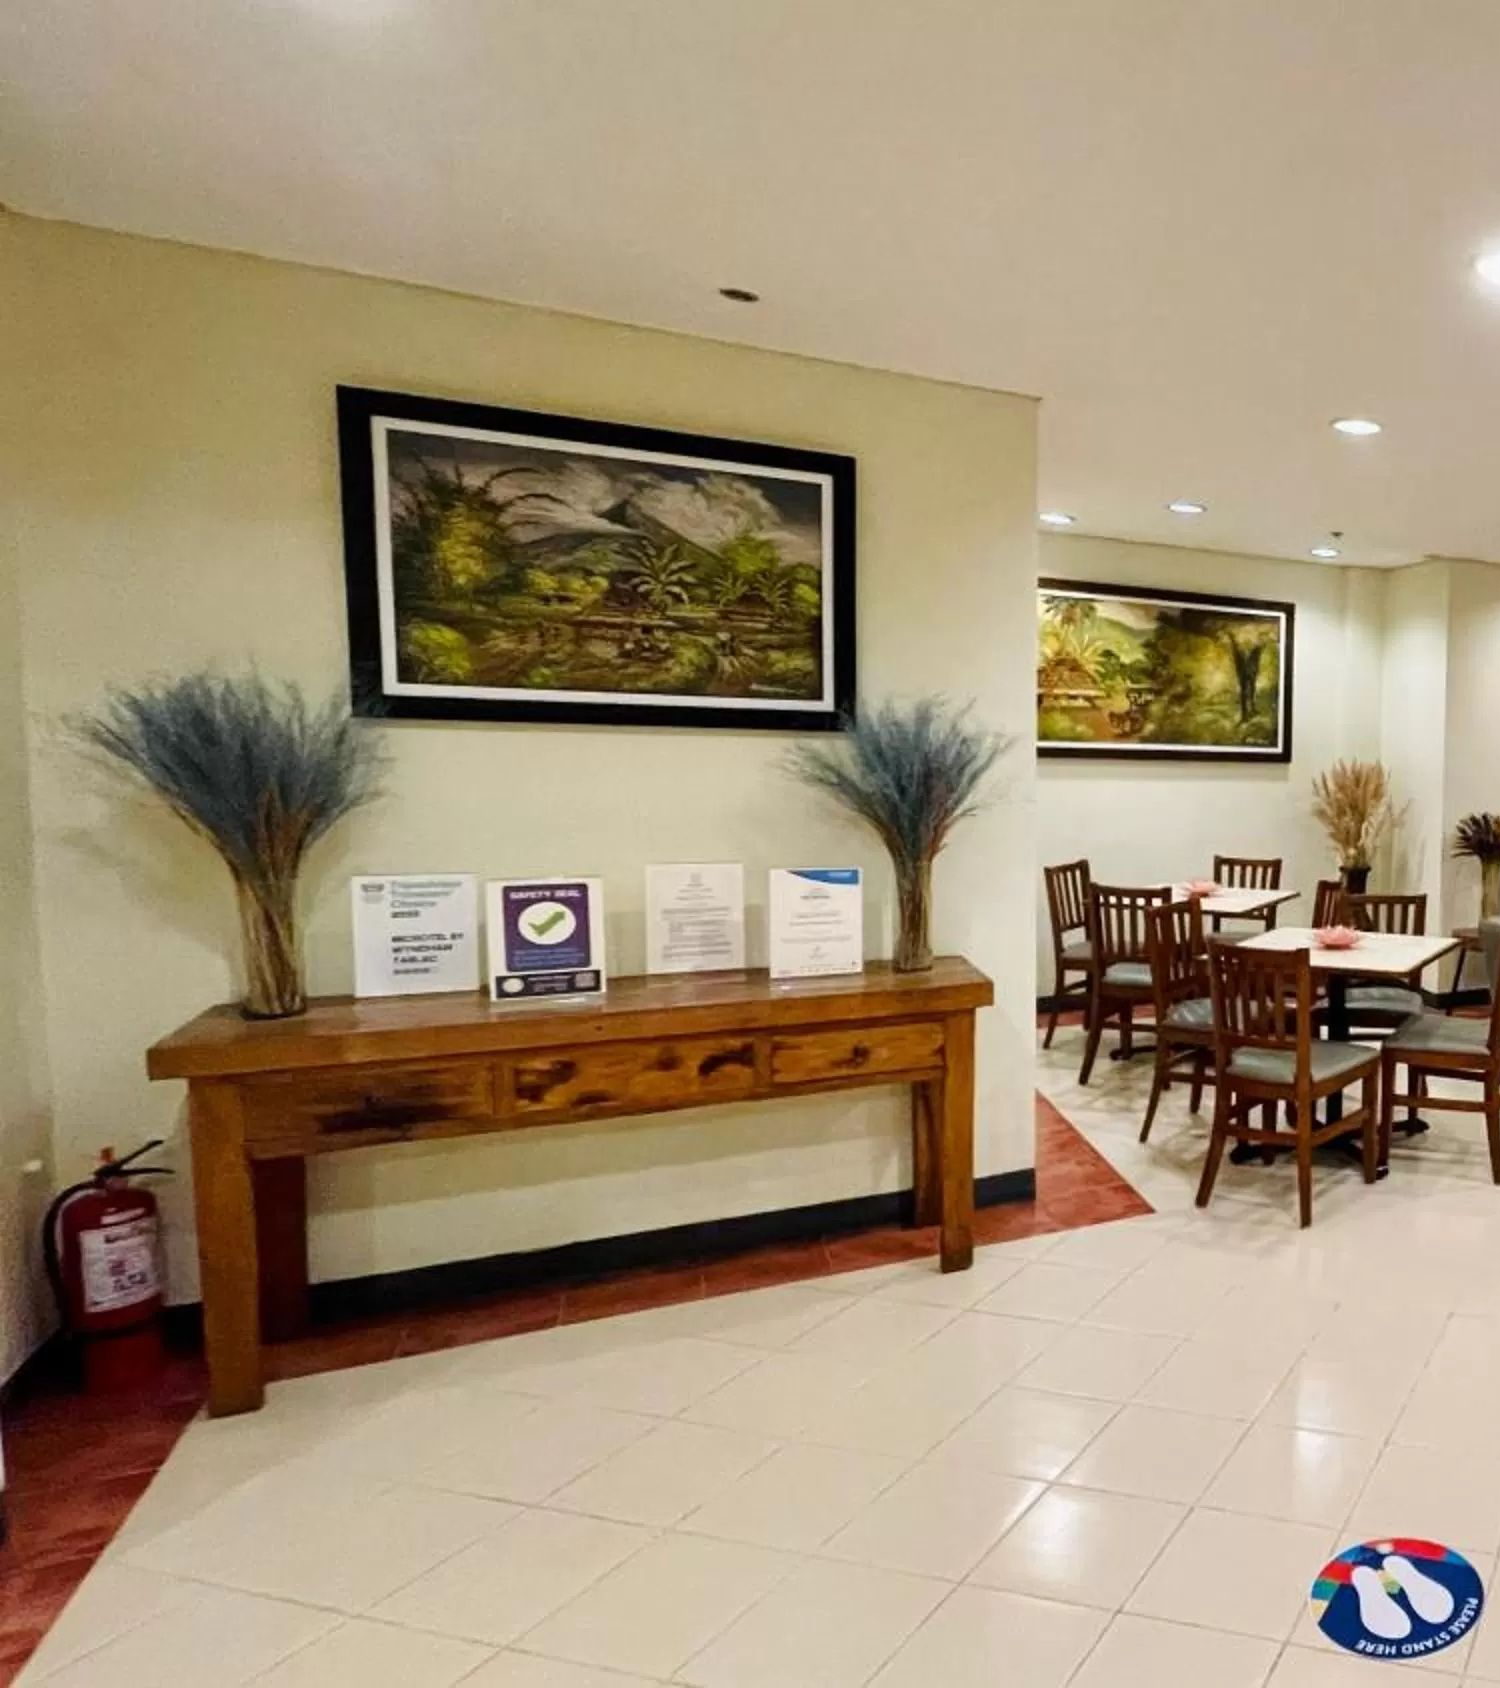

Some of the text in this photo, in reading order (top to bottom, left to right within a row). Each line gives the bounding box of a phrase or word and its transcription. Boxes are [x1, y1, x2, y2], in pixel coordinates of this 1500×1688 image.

[1354, 1597, 1479, 1655] PLEASE STAND HERE
